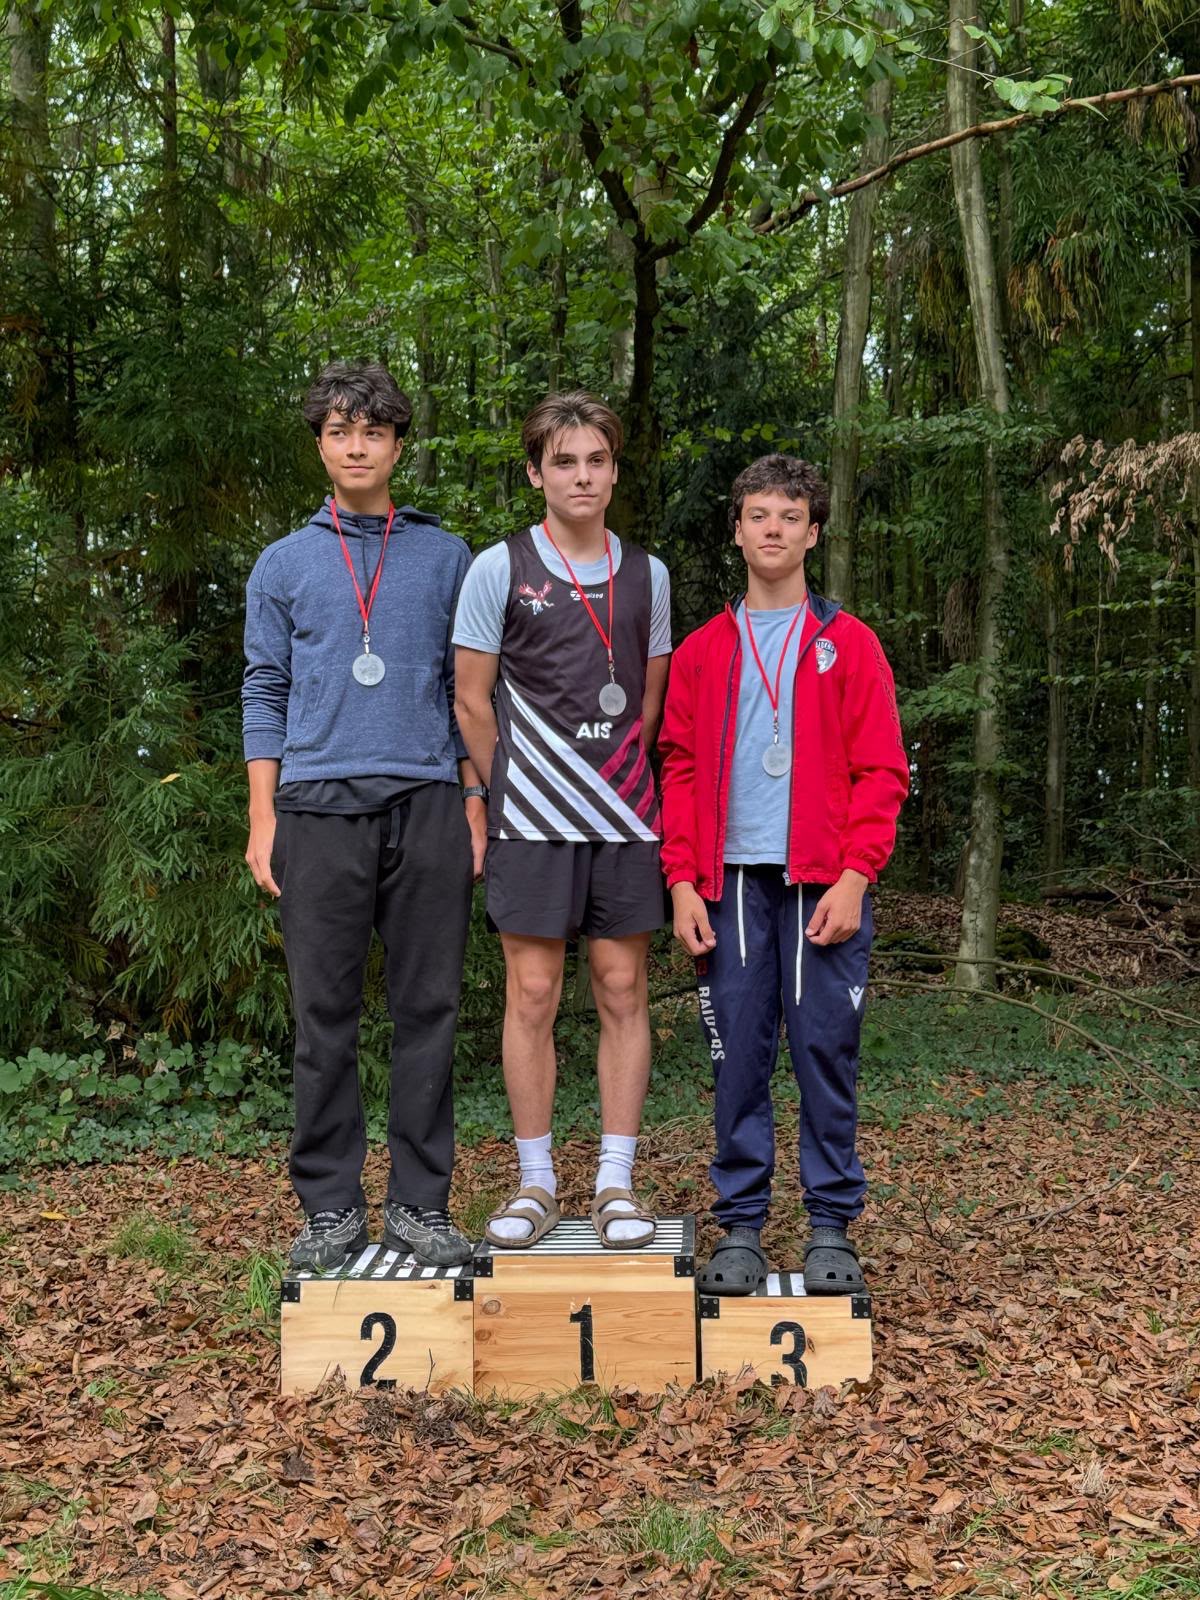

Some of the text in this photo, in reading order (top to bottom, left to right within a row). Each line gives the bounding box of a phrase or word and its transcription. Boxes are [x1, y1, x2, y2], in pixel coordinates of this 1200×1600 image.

[576, 721, 613, 739] AIS
[360, 1312, 398, 1390] 2
[569, 1304, 595, 1381] 1
[769, 1321, 808, 1389] 3
